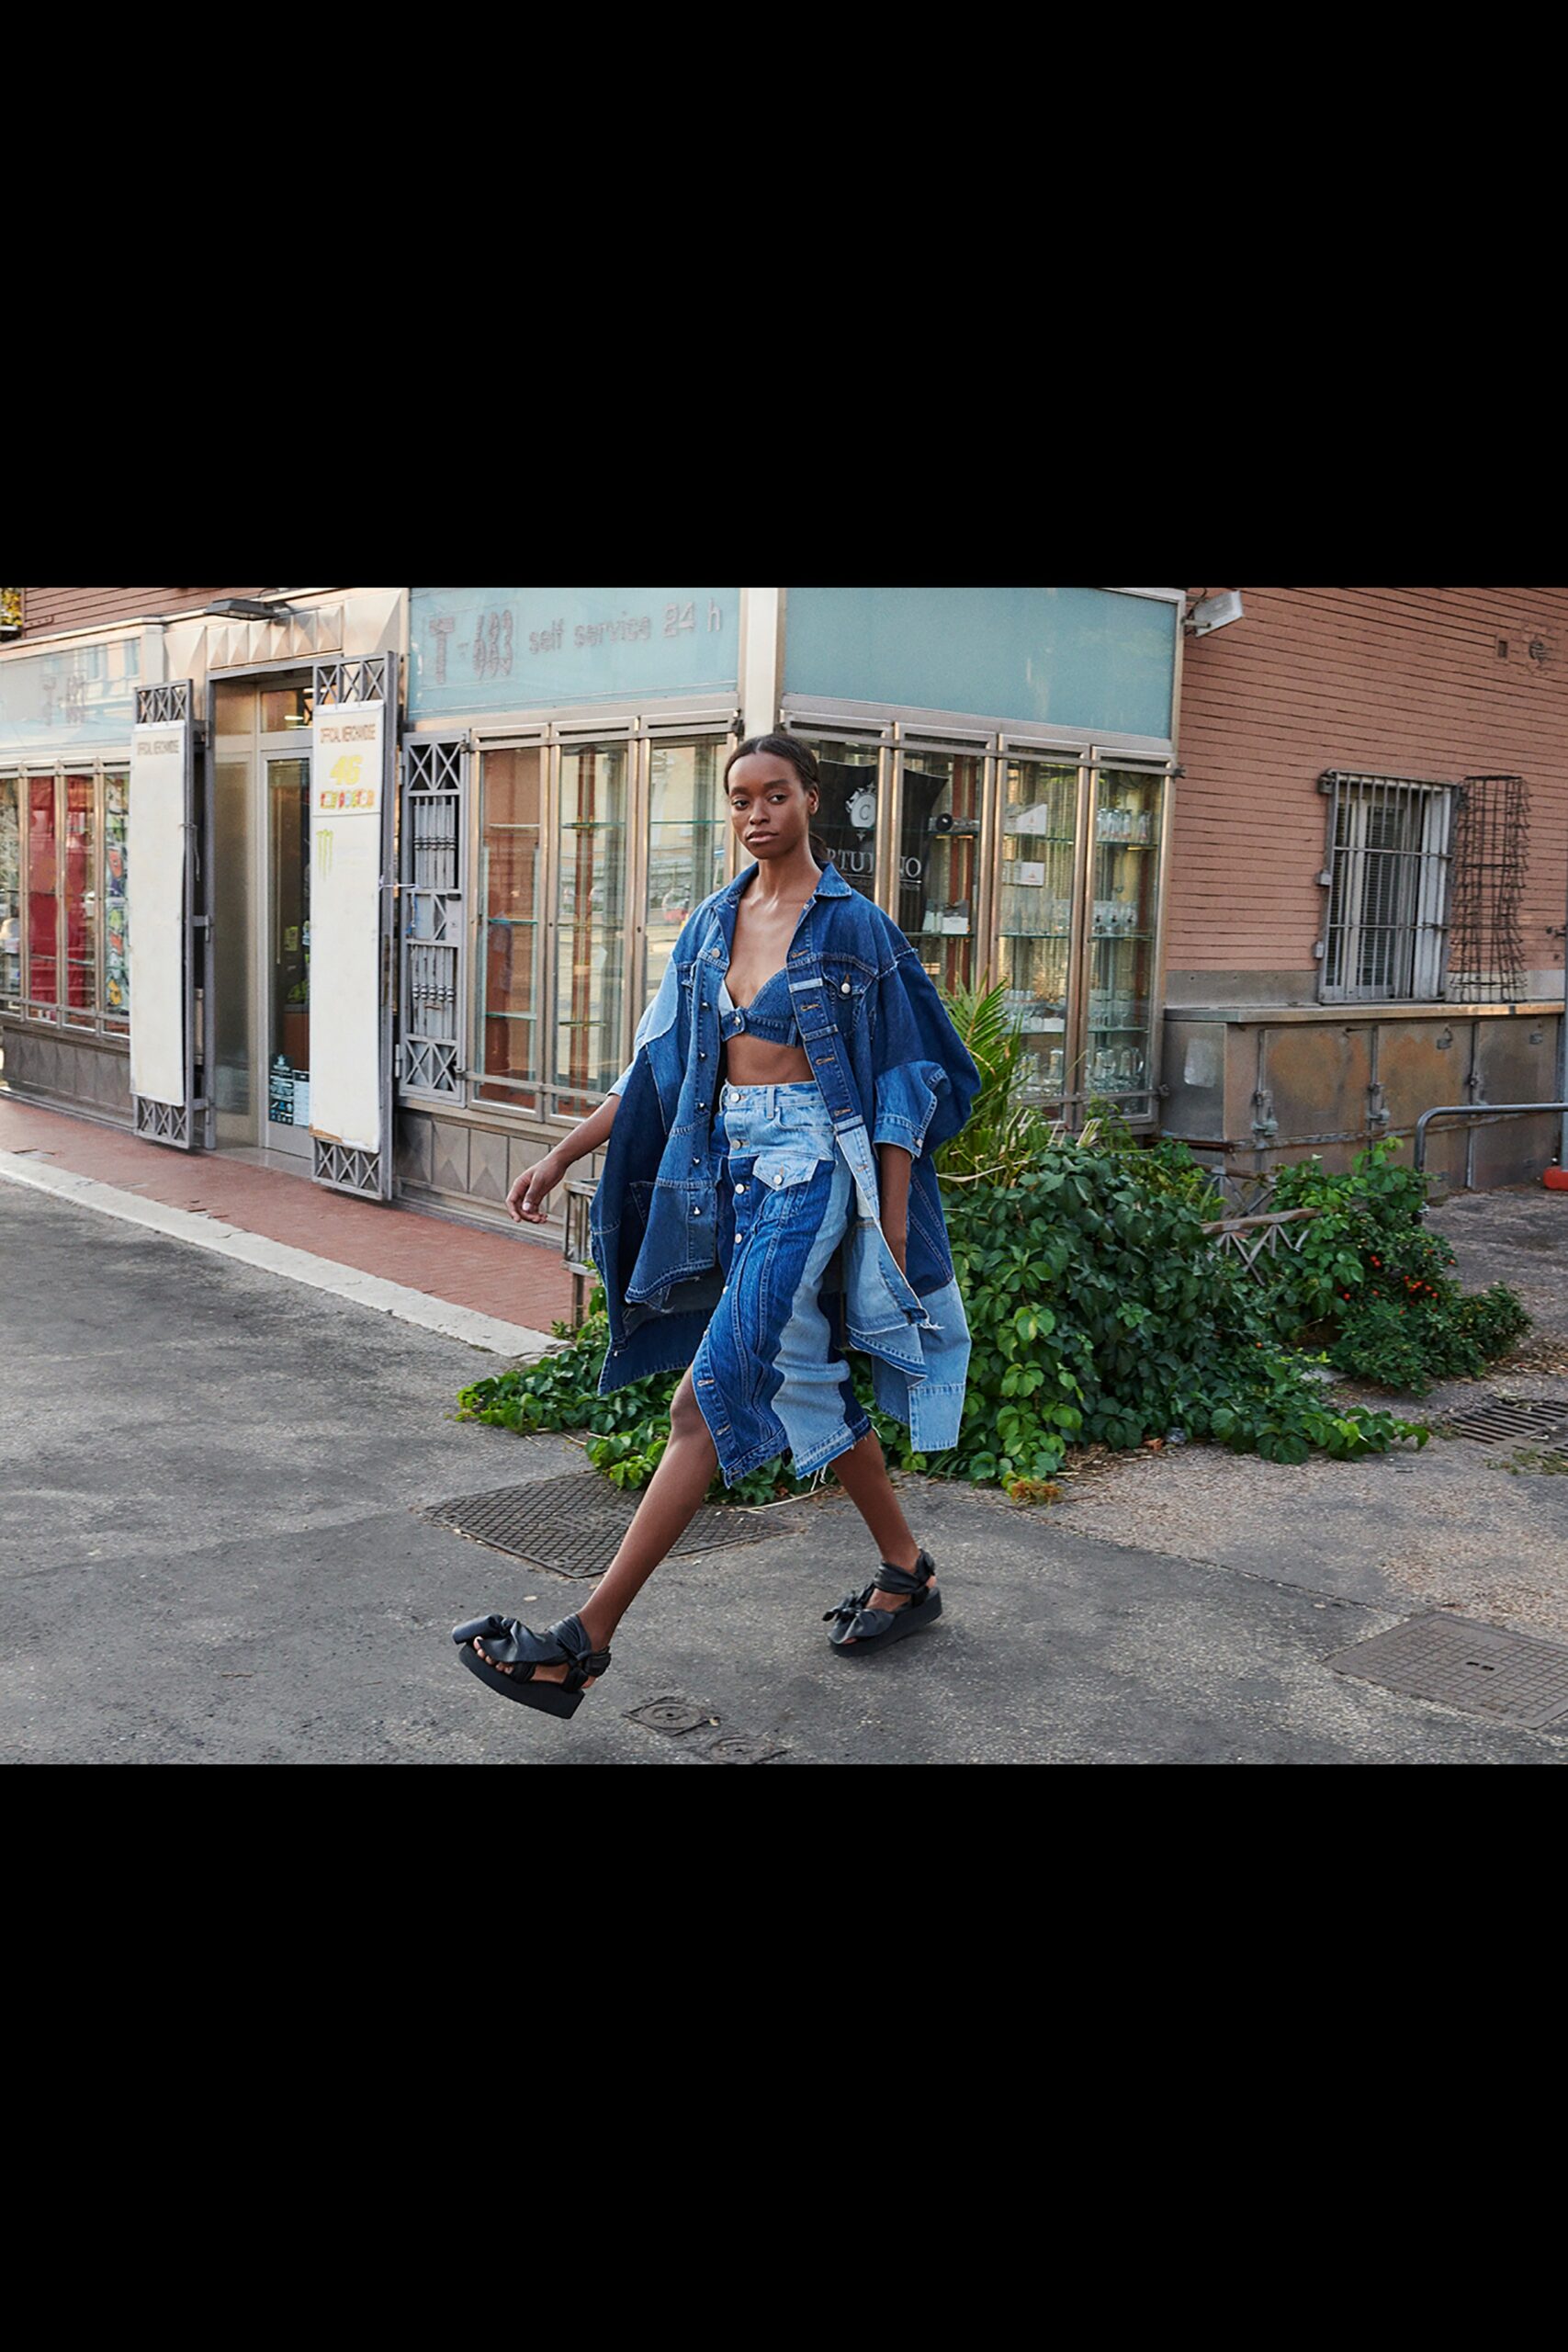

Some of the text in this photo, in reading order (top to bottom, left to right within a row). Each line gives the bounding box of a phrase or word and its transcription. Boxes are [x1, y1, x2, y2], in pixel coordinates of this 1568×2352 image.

[528, 617, 565, 655] self
[573, 610, 651, 649] service
[662, 602, 695, 639] 24
[706, 597, 722, 632] h
[330, 754, 365, 786] 46
[859, 804, 872, 821] C
